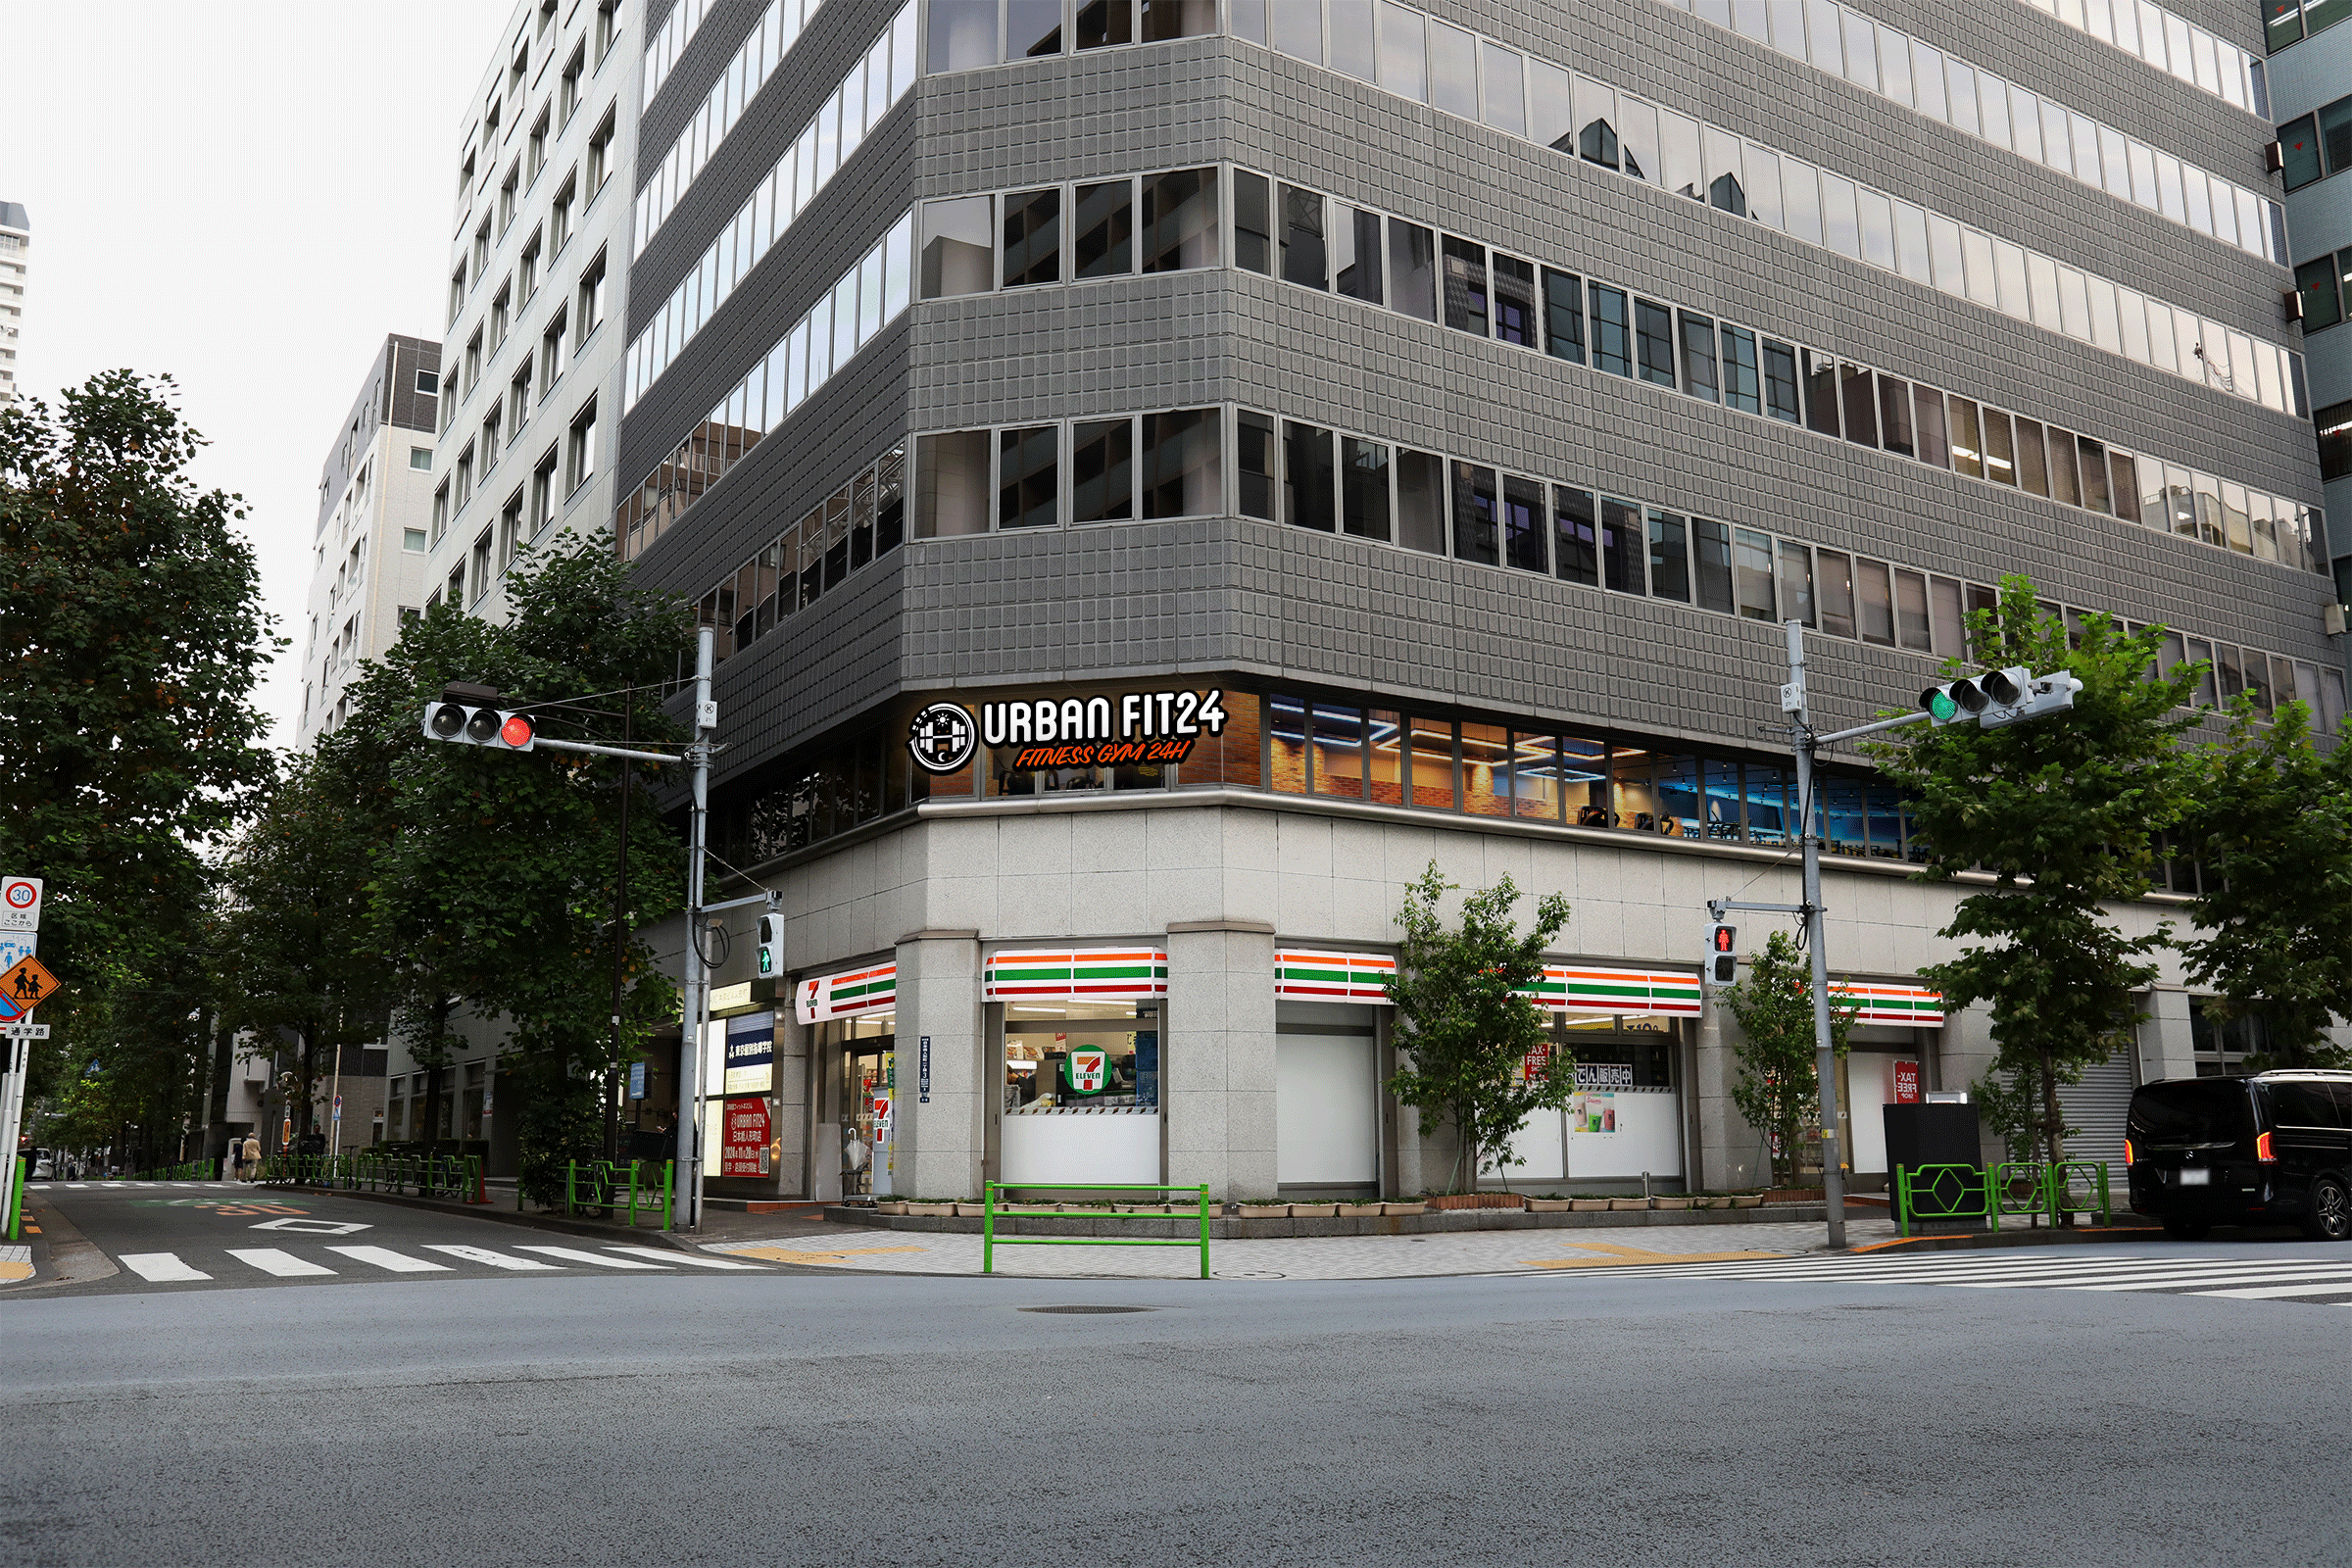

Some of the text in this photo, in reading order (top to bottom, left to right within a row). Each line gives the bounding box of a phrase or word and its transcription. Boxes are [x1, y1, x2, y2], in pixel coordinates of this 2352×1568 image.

[984, 690, 1225, 745] URBAN FIT24
[1015, 740, 1191, 768] FITNESS GYM 24H
[12, 889, 30, 903] 30
[11, 1026, 45, 1037] 通学路
[1529, 1045, 1545, 1055] AX-
[1570, 1067, 1631, 1084] でん販売中
